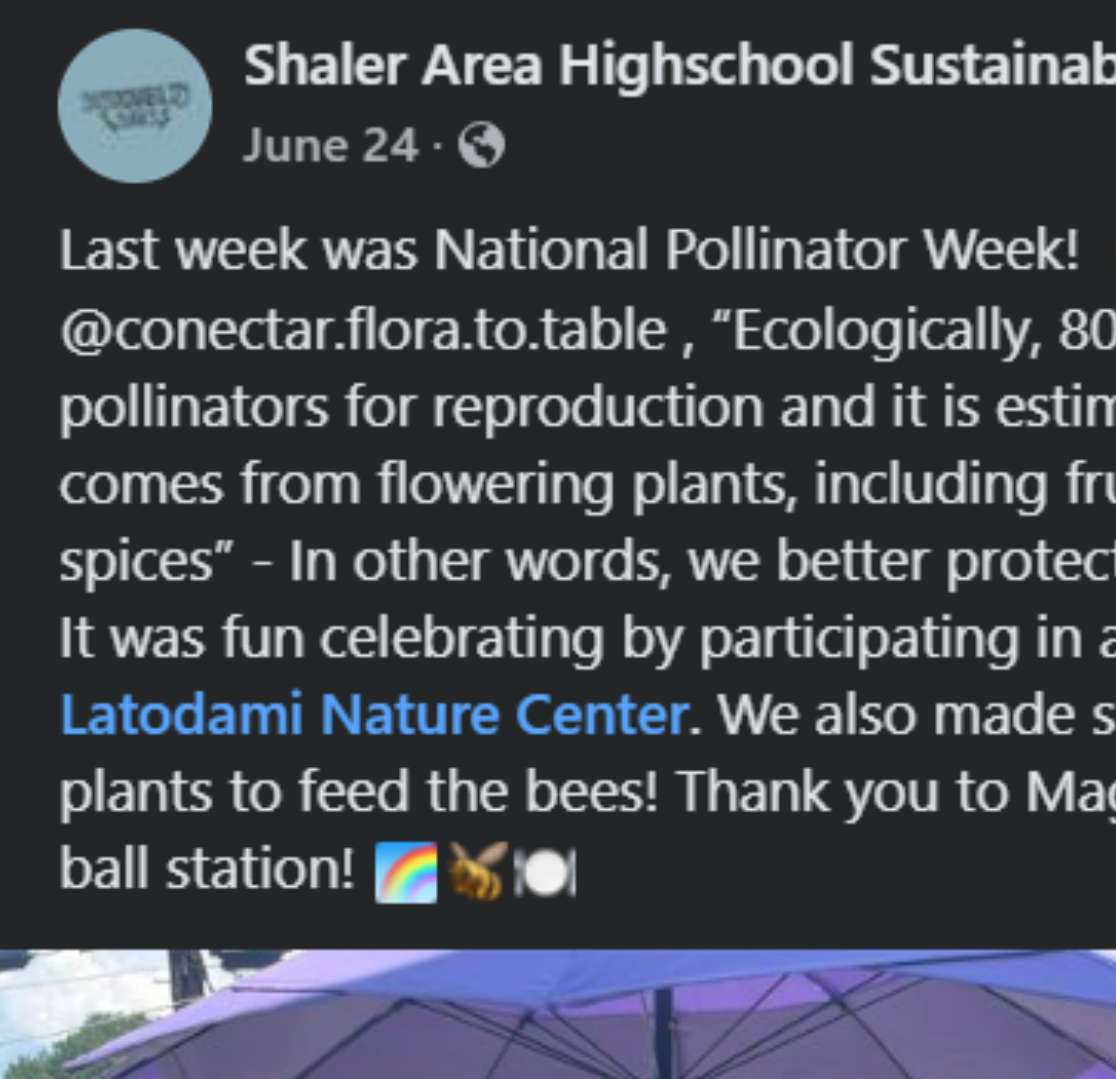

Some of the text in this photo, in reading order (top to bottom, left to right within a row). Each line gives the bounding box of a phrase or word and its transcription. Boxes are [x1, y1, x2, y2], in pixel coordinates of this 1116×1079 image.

[245, 40, 409, 85] Shaler
[421, 43, 542, 85] Area
[560, 38, 853, 98] Highschool
[243, 127, 419, 162] June 24
[61, 228, 160, 270] Last
[174, 225, 308, 270] week
[321, 237, 419, 270] was
[436, 225, 647, 270] National
[667, 225, 909, 270] Pollinator
[922, 225, 1078, 270] Week!
[61, 305, 668, 356] @conectar.flora.to.table
[712, 305, 1041, 362] “Ecologically,
[61, 382, 330, 439] pollinators
[344, 382, 419, 427] for
[434, 382, 763, 439] reproduction
[780, 382, 875, 427] and
[893, 382, 927, 427] it
[945, 382, 980, 427] is
[59, 471, 225, 504] comes
[239, 459, 360, 504] from
[376, 459, 613, 516] flowering
[634, 459, 798, 516] plants,
[816, 459, 1047, 516] including
[60, 536, 234, 593] spices”
[292, 539, 336, 581] In
[353, 536, 492, 581] other
[504, 536, 671, 590] words,
[686, 548, 761, 581] we
[778, 536, 932, 581] better
[61, 616, 95, 658] It
[108, 625, 206, 658] was
[221, 613, 304, 658] fun
[319, 613, 604, 670] celebrating
[624, 613, 685, 670] by
[701, 613, 1019, 670] participating
[1037, 613, 1082, 658] in
[62, 688, 302, 735] Latodami
[322, 693, 500, 735] Nature
[516, 693, 701, 735] Center.
[717, 693, 800, 735] We
[815, 690, 918, 735] also
[935, 690, 1076, 735] made
[61, 767, 213, 824] plants
[228, 770, 283, 812] to
[298, 767, 409, 812] feed
[425, 767, 509, 812] the
[526, 767, 657, 812] bees!
[674, 767, 832, 812] Thank
[843, 779, 938, 824] you
[954, 770, 1010, 812] to
[61, 844, 354, 889] ball station!
